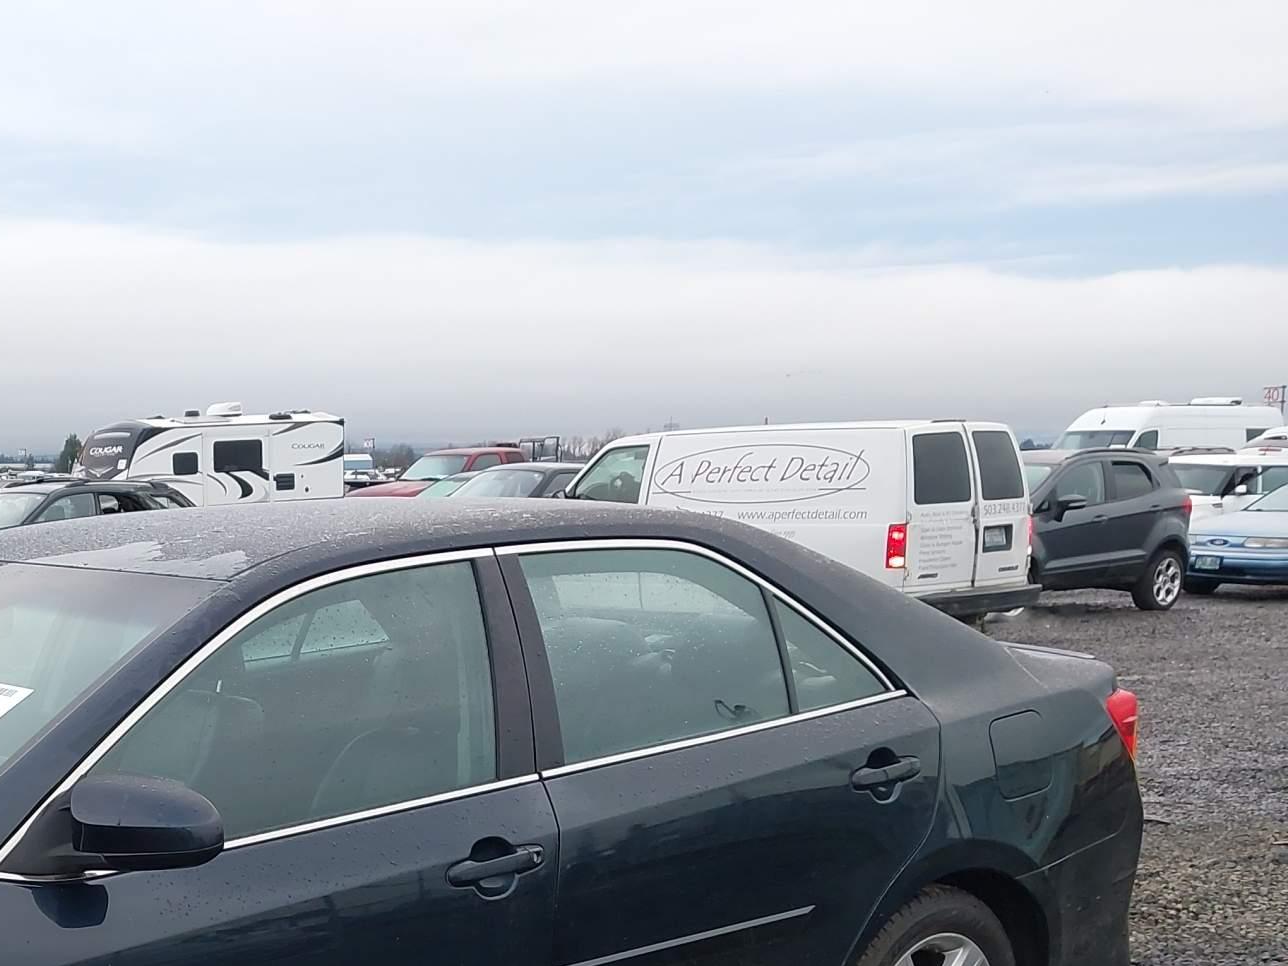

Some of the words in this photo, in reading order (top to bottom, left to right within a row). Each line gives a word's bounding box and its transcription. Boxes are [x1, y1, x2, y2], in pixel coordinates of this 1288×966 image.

[1264, 388, 1279, 400] 40
[89, 445, 123, 456] COUGAR
[291, 442, 325, 450] COUGAR
[660, 461, 684, 486] A
[691, 451, 777, 484] Perfect
[780, 449, 865, 484] Detail
[737, 508, 868, 522] www.aperfectdetail.com
